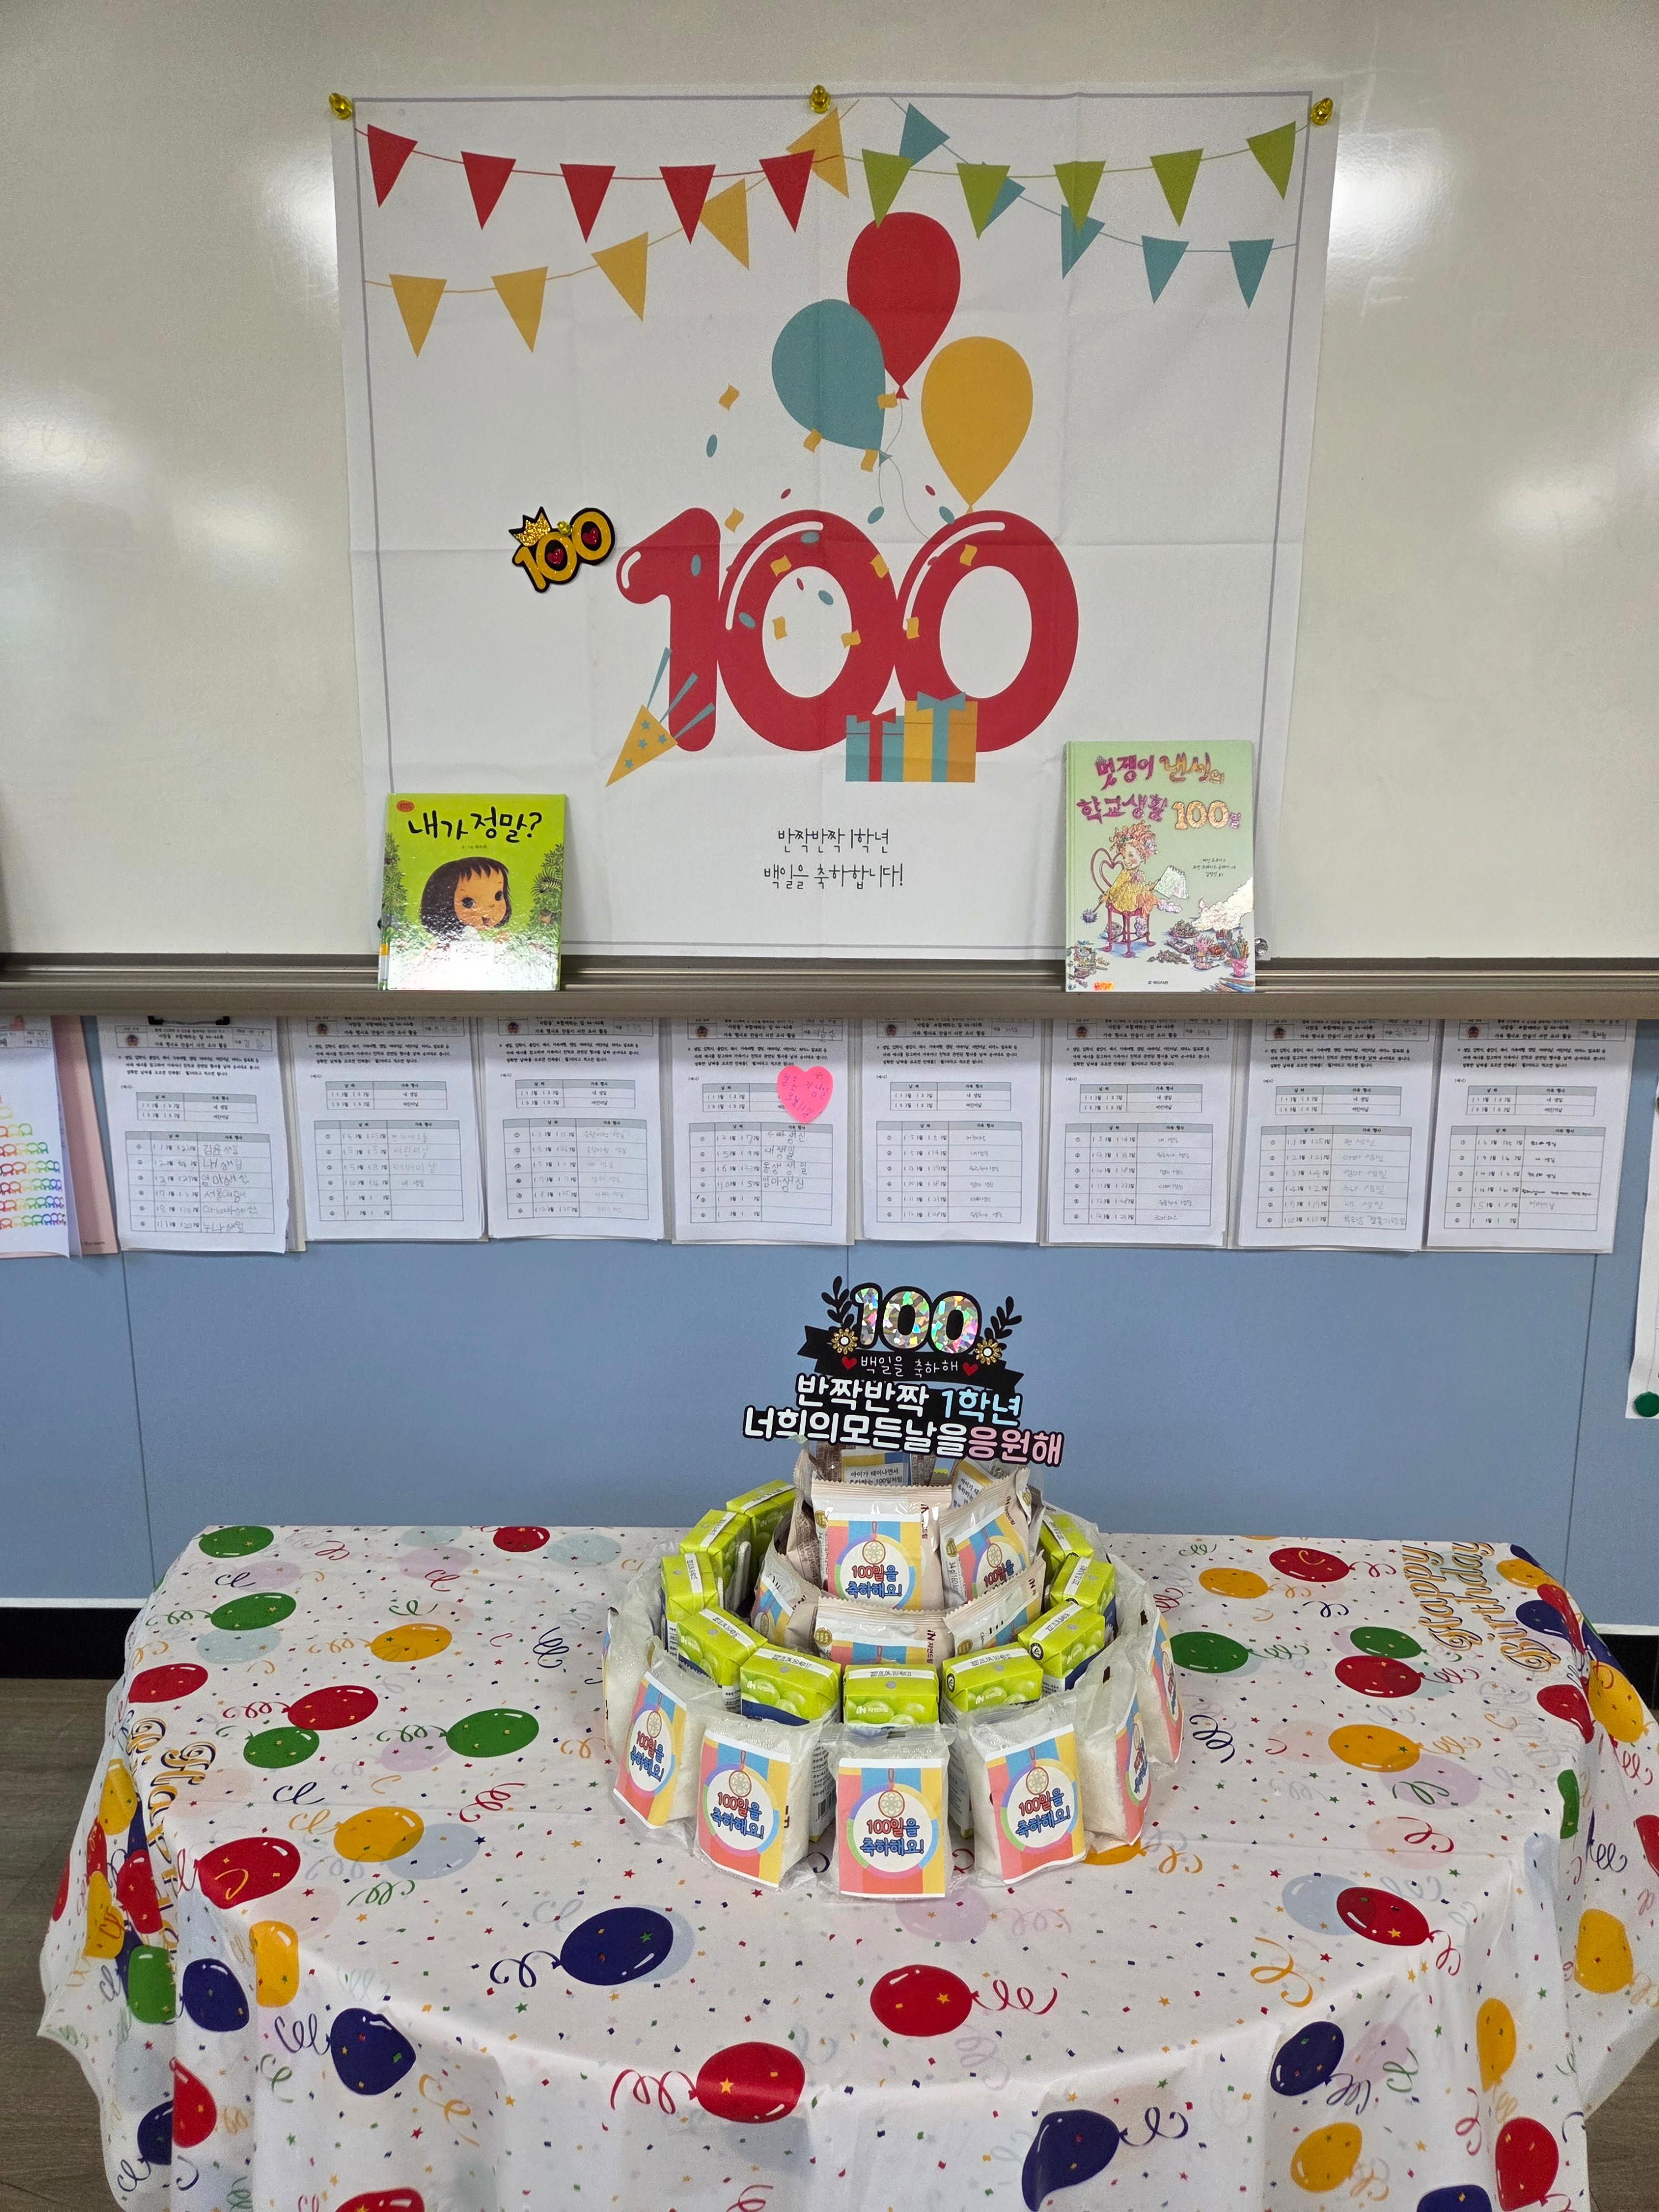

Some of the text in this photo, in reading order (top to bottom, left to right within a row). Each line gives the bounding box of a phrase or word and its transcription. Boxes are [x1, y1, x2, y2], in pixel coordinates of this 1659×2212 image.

[514, 511, 612, 591] 100
[616, 508, 1079, 752] 100
[1095, 752, 1224, 790] 멋쟁이 낸시의
[408, 806, 542, 843] 내가 정말?
[1077, 793, 1241, 830] 학교생활 100일
[779, 828, 845, 853] 반짝반짝
[764, 863, 903, 889] 백일을 축하합니다!
[852, 1285, 980, 1355] 100
[860, 1355, 959, 1379] 백일을 축하해
[797, 1375, 1022, 1427] 반짝반짝 1학년
[845, 1580, 902, 1599] 축하해요!
[852, 1564, 899, 1582] 100일을
[984, 1559, 1014, 1588] 100일을
[630, 1745, 665, 1782] 축하해요!
[636, 1730, 665, 1764] 100일을
[717, 1791, 763, 1822] 100일을
[1018, 1787, 1065, 1817] 100일을
[711, 1807, 765, 1840] 축하해요!
[866, 1817, 920, 1838] 100일을
[1015, 1805, 1071, 1838] 축하해요!
[859, 1837, 925, 1857] 축하해요!
